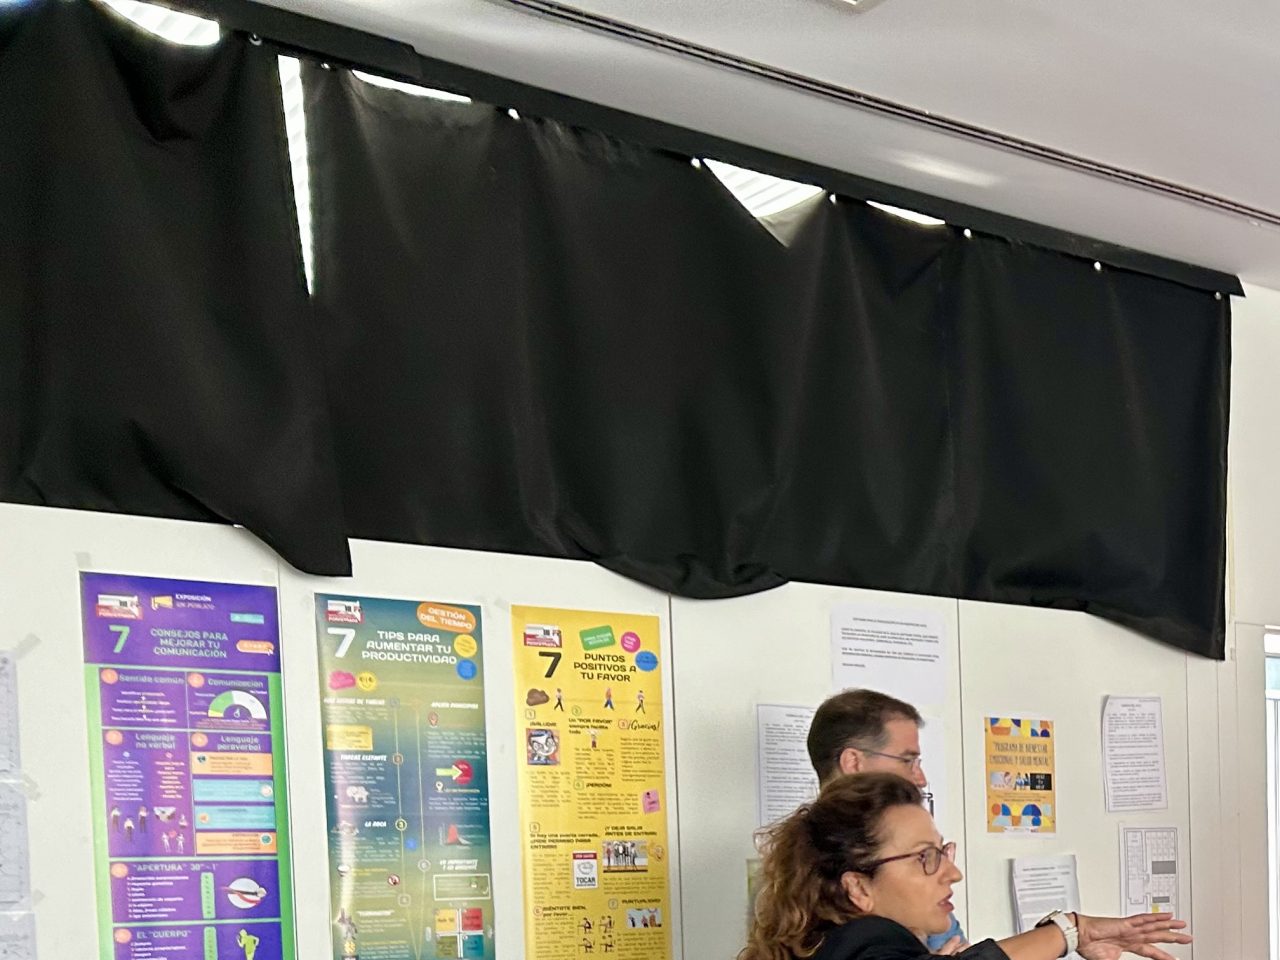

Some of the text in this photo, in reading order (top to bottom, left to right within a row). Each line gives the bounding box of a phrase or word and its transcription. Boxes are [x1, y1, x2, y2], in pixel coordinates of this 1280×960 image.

[427, 606, 466, 620] GESTIÓN
[419, 614, 473, 630] DEL TIEMPO
[109, 624, 130, 653] 7
[150, 628, 228, 641] CONSEJOS PARA
[376, 630, 440, 643] TIPS PARA
[160, 638, 220, 648] MEJORAR TU
[327, 627, 356, 658] 7
[366, 640, 452, 654] AUMENTAR TU
[361, 650, 458, 665] PRODUCTIVIDAD
[584, 653, 626, 663] PUNTOS
[538, 651, 562, 678] 7
[574, 662, 626, 672] POSITIVOS
[580, 672, 631, 682] TU FAVOR
[576, 876, 596, 884] TOCAR
[136, 931, 148, 939] EL
